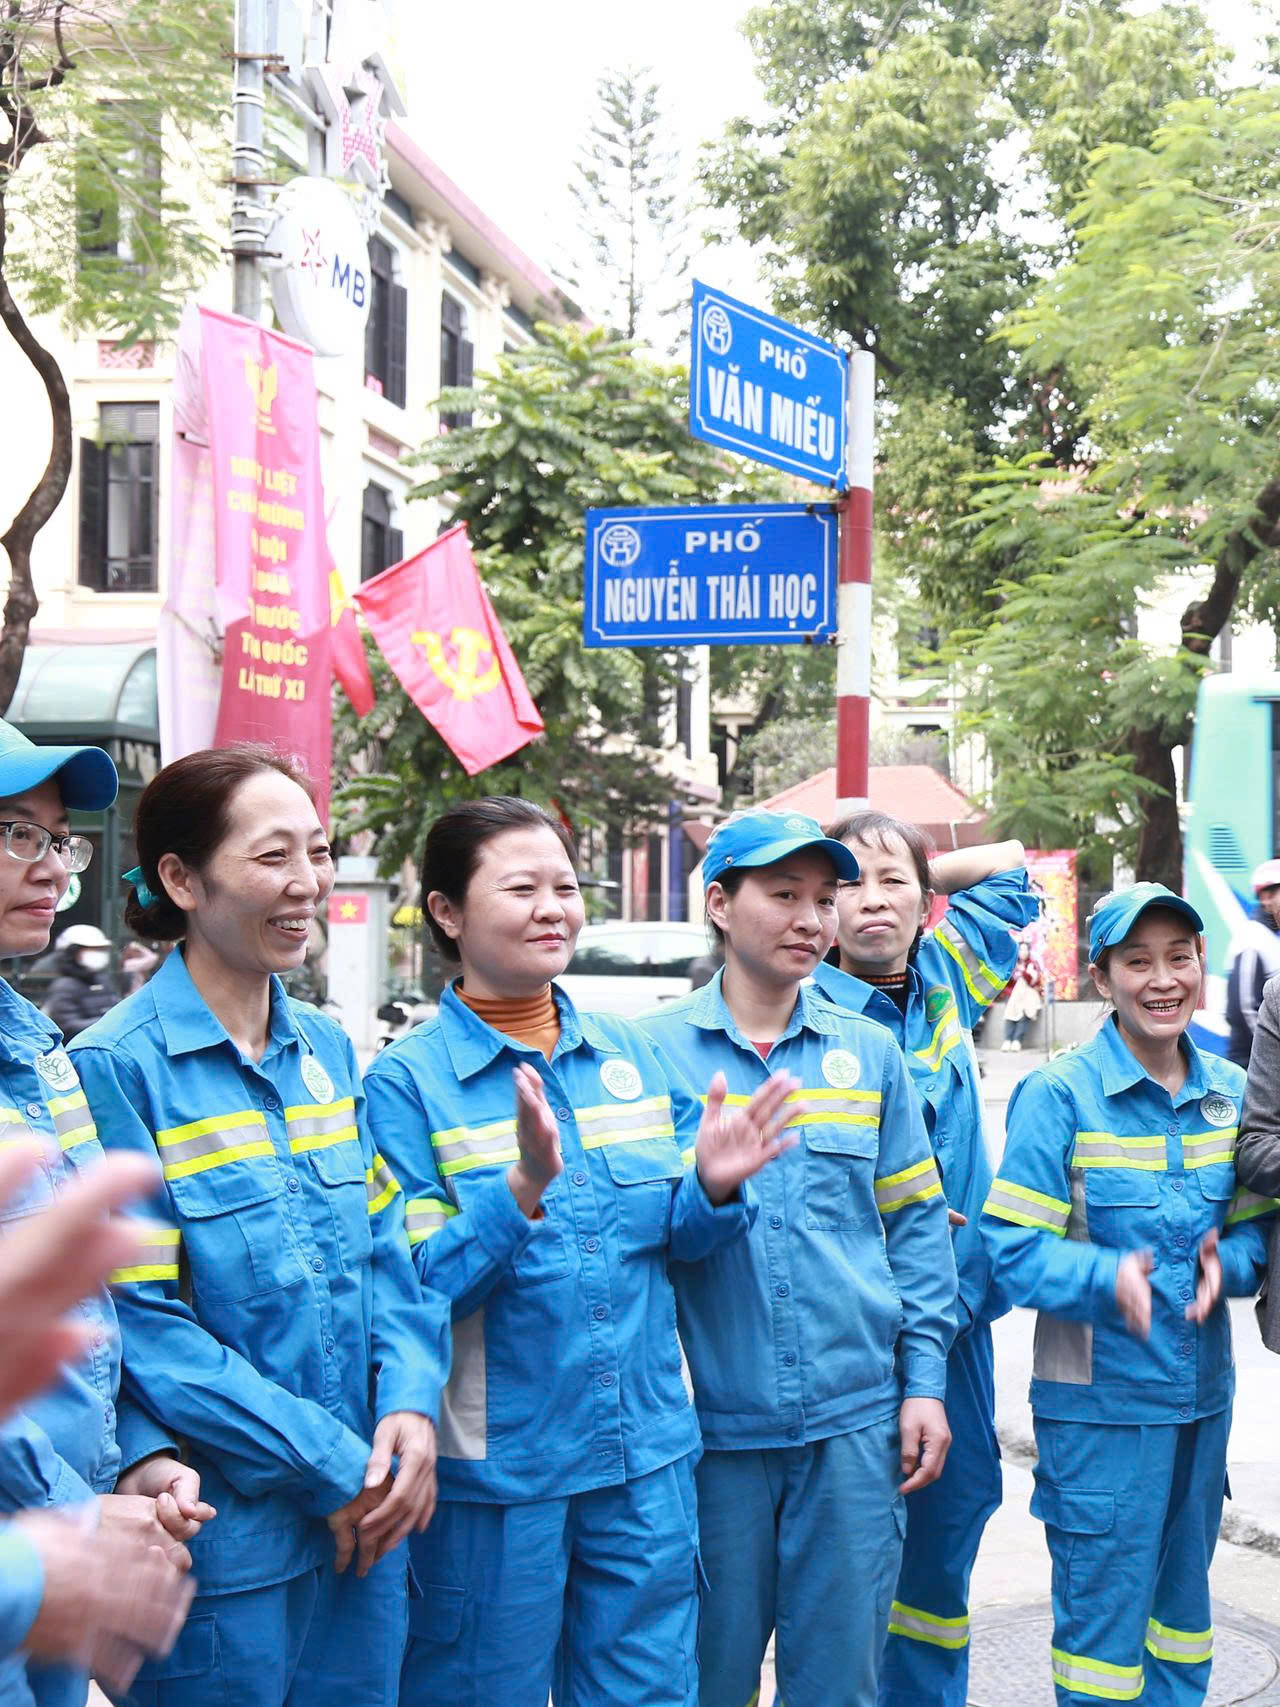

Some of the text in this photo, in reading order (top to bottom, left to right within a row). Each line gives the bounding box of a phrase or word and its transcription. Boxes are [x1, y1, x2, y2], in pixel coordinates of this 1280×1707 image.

[331, 253, 366, 308] MB
[759, 338, 808, 380] PHỐ
[707, 362, 836, 462] VĂN MIẾU
[684, 518, 765, 554] PHỐ
[604, 559, 817, 629] NGUYỄN THÁI HỌC
